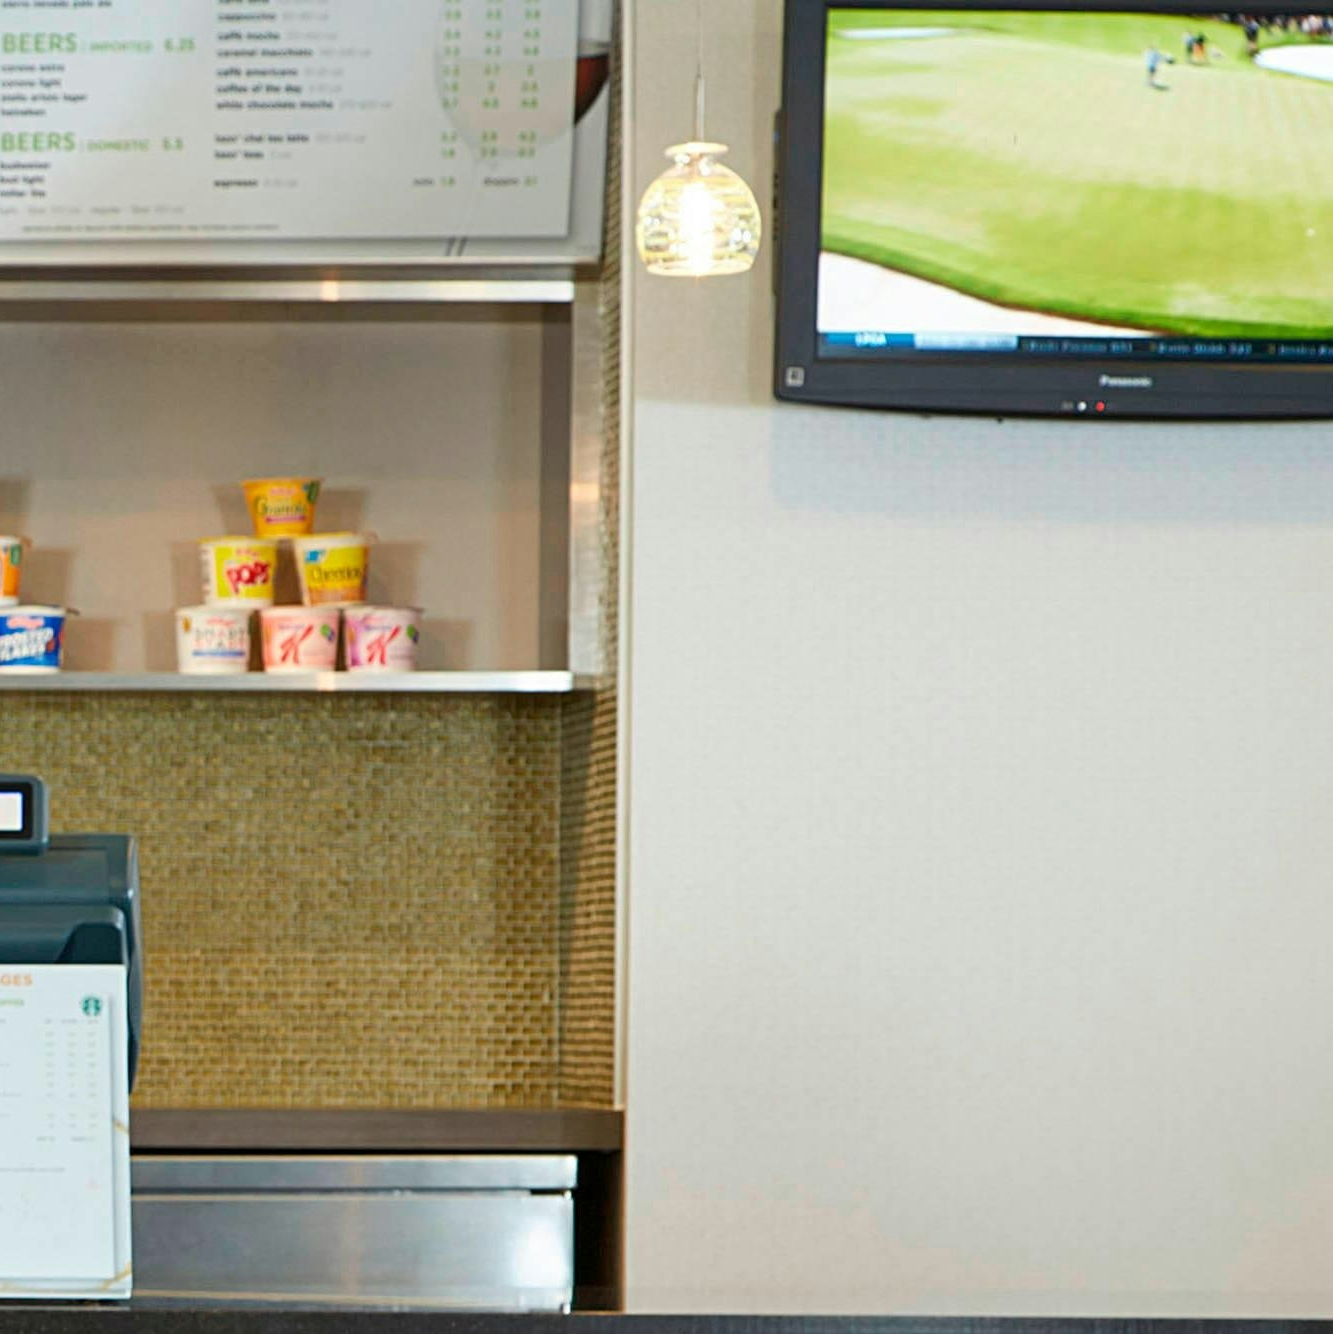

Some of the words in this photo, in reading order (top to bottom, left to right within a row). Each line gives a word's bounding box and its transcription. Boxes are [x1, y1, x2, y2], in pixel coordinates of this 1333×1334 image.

[1, 32, 78, 53] BEERS
[0, 132, 76, 152] BEERS
[1099, 374, 1152, 387] Panasonic
